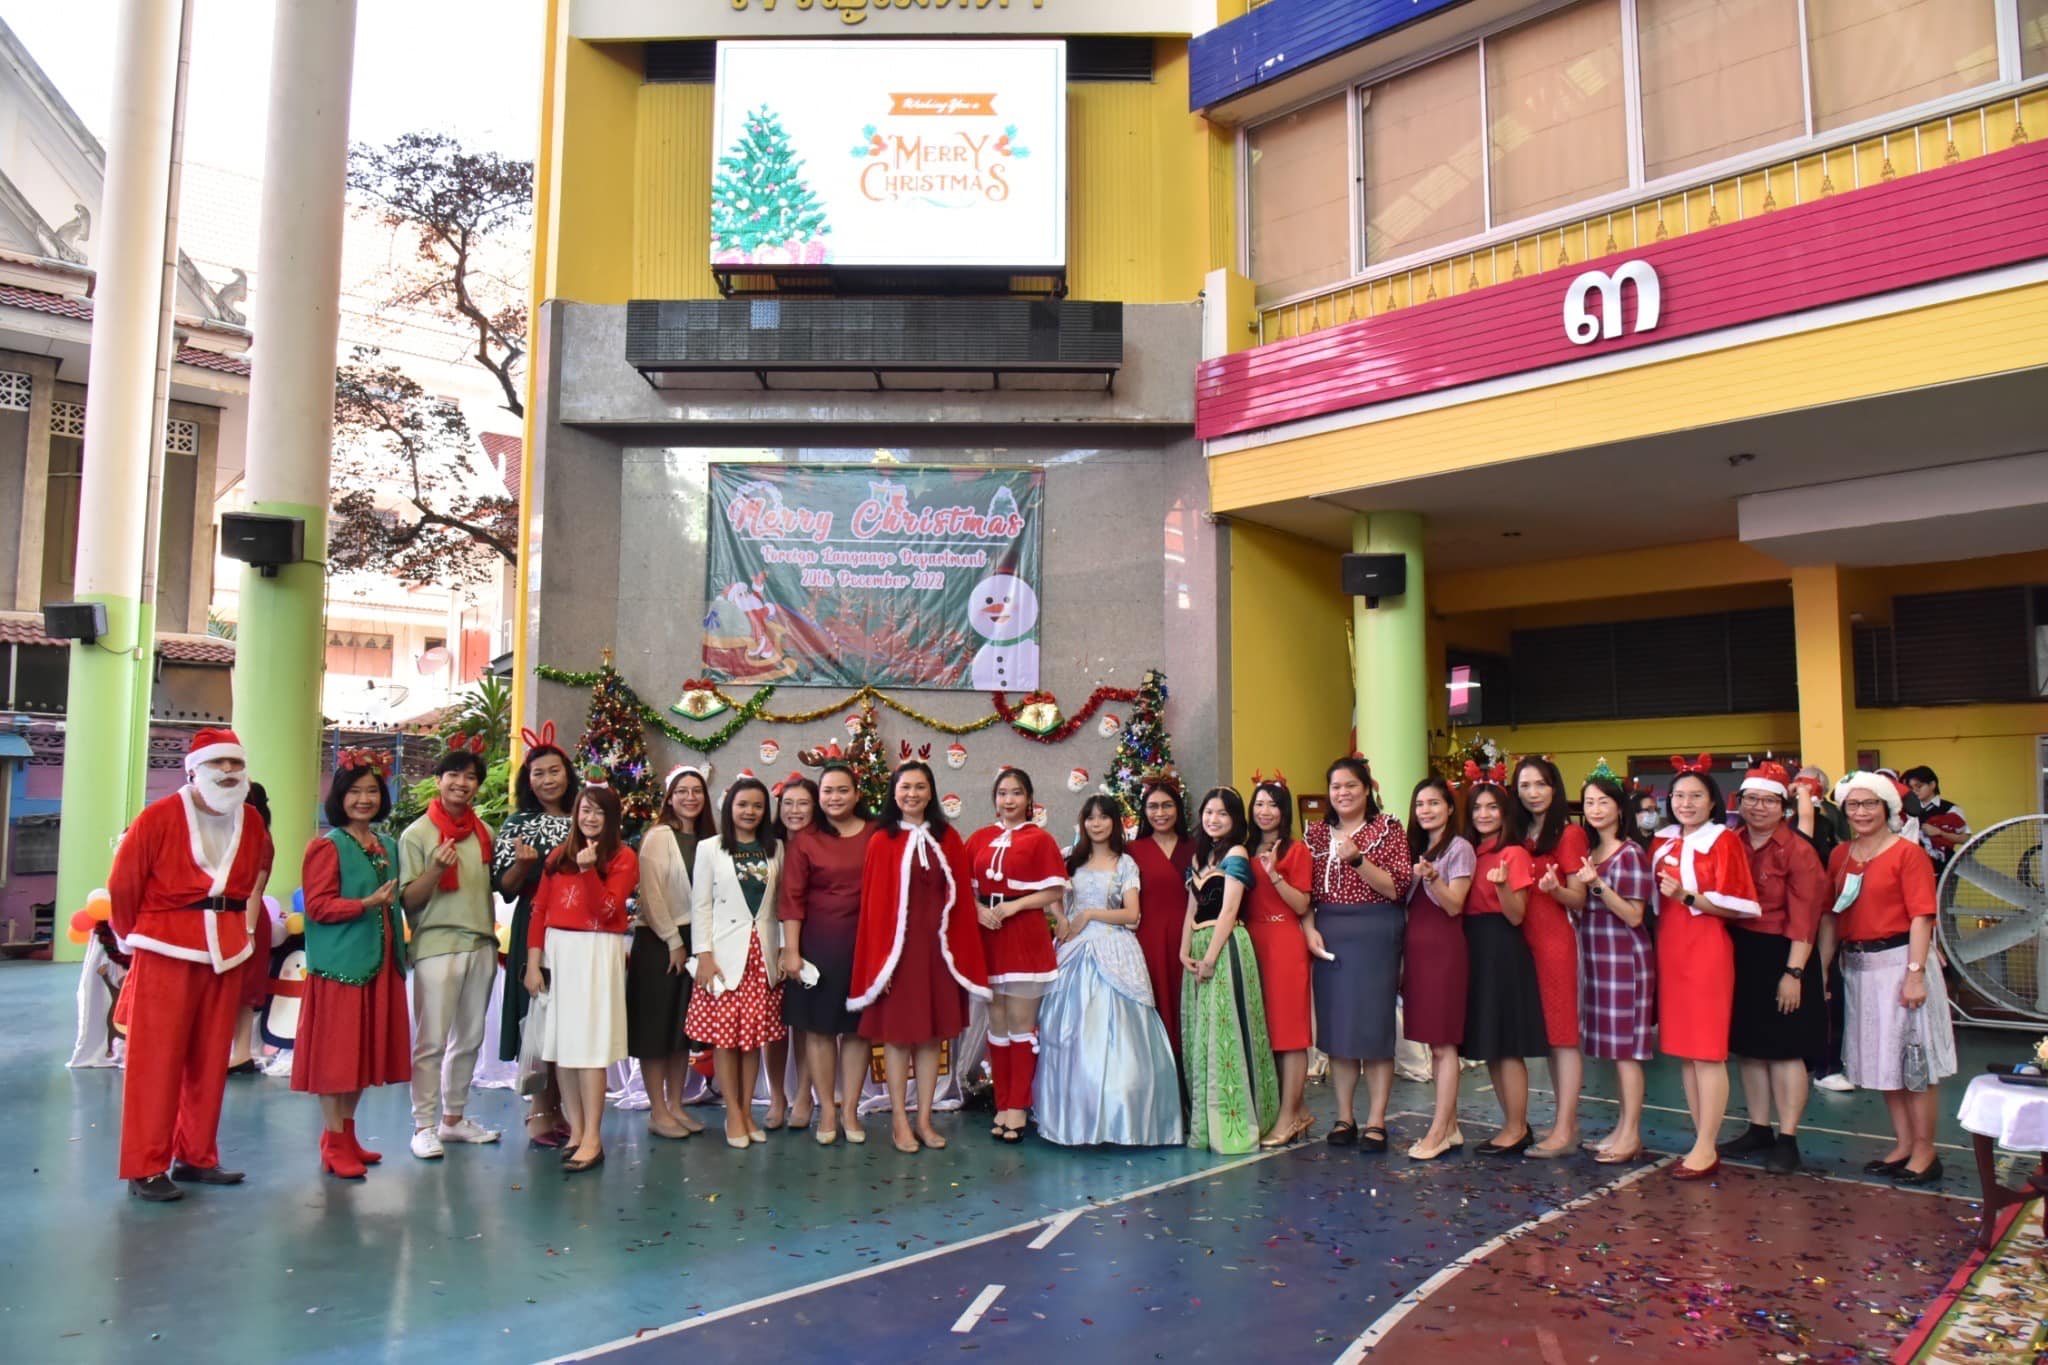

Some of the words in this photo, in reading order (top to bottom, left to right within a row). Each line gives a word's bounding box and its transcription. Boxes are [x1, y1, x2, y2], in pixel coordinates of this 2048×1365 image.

[888, 131, 989, 171] MERRY
[860, 161, 1009, 202] CHRISTMAS
[1563, 260, 1660, 345] ๓
[728, 498, 832, 543] Merry
[852, 500, 1025, 539] Christmas
[761, 545, 819, 567] Foreign
[821, 546, 897, 569] Language
[899, 548, 986, 570] Department
[801, 568, 834, 587] 20th
[837, 569, 911, 589] December
[912, 571, 945, 589] 2022
